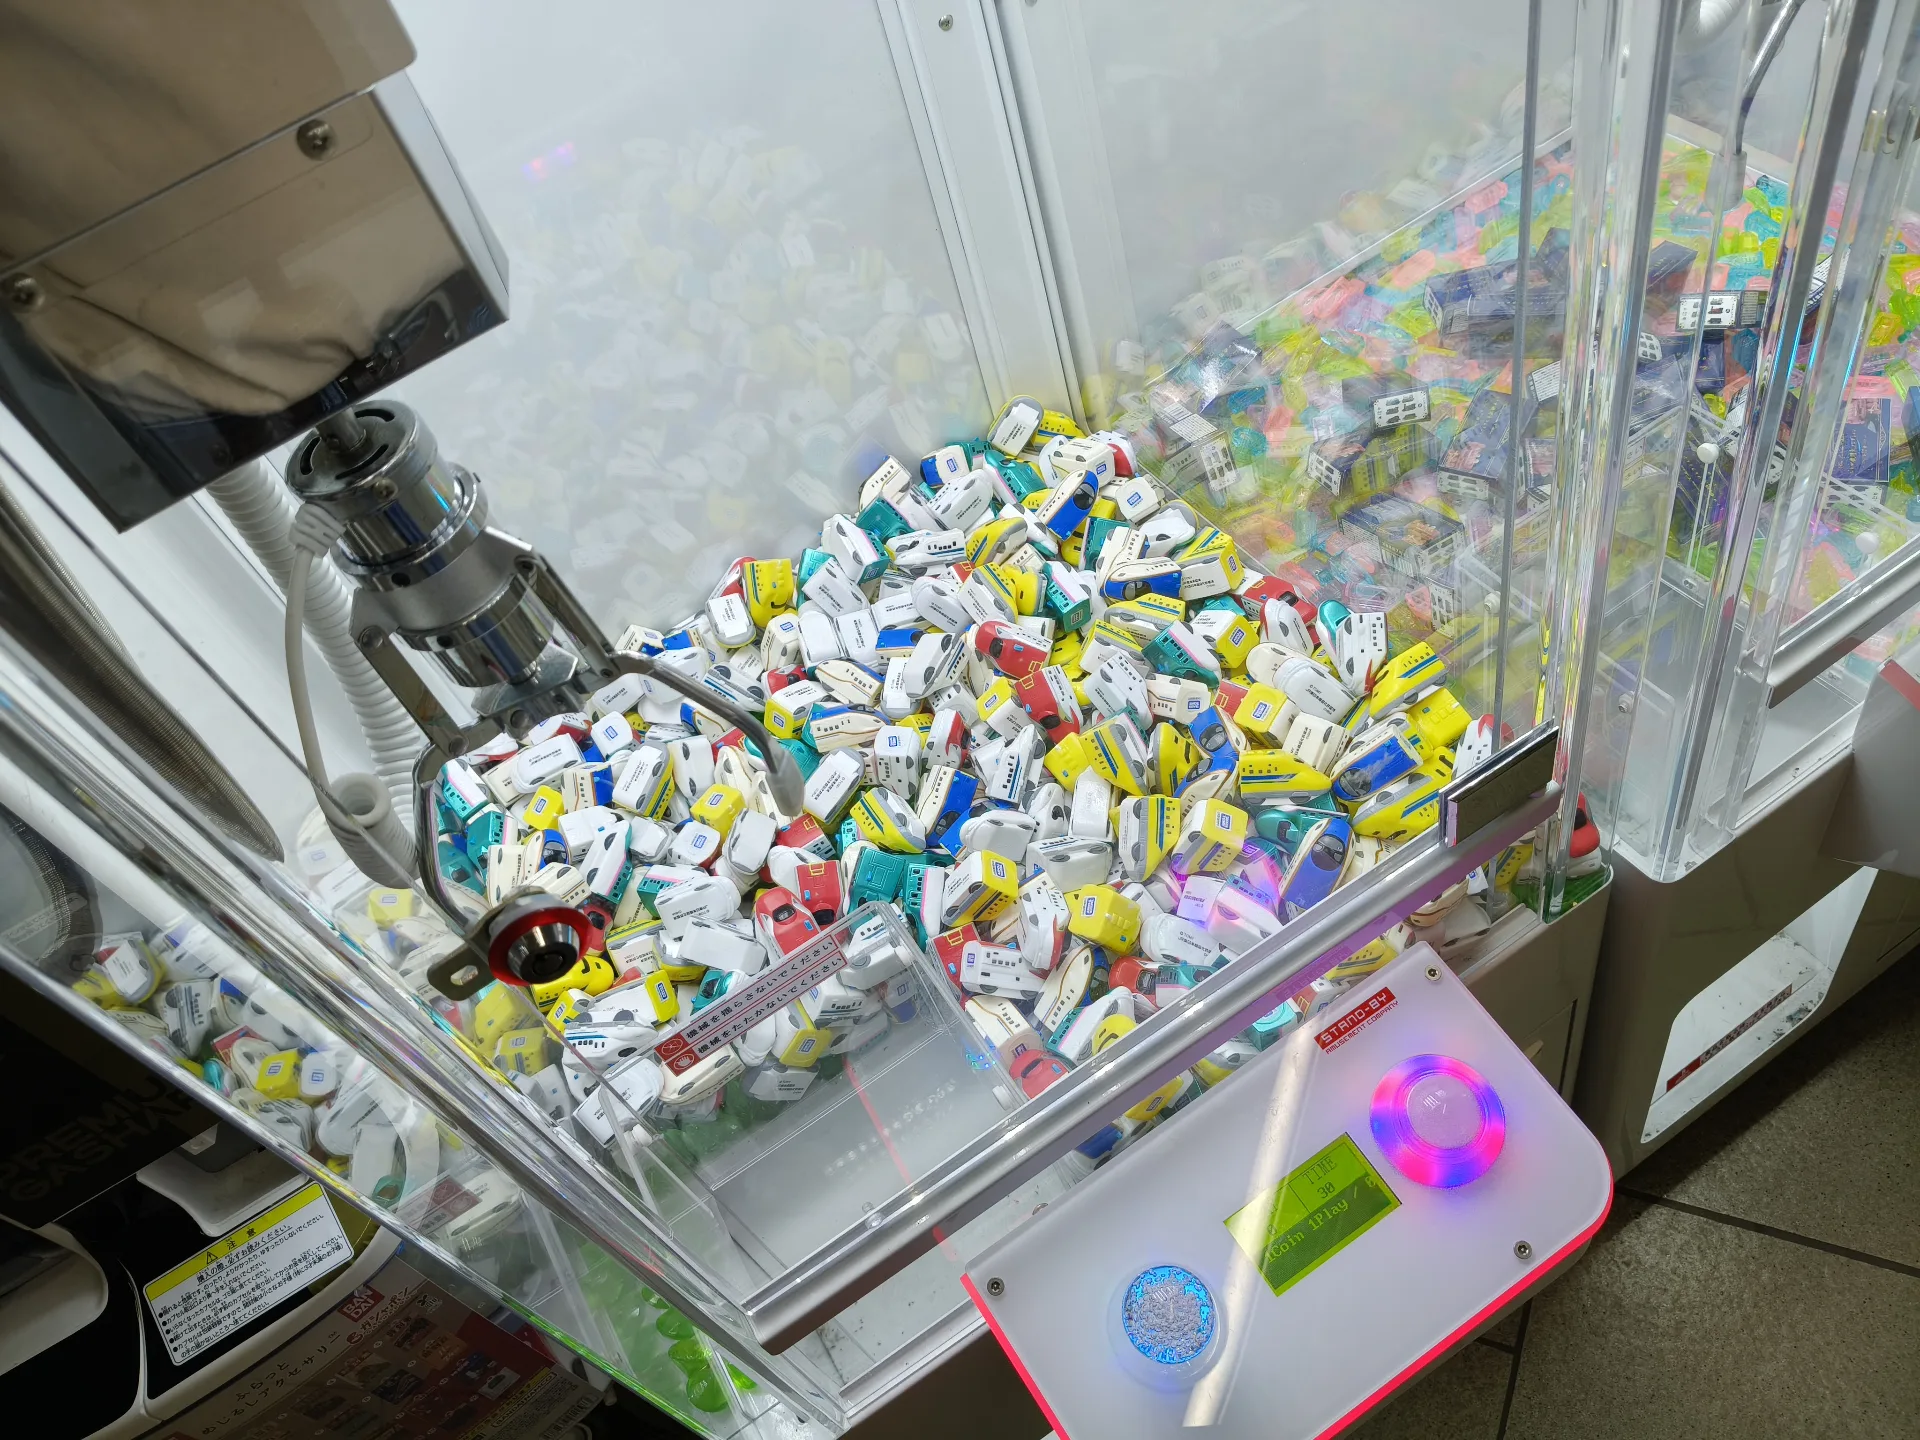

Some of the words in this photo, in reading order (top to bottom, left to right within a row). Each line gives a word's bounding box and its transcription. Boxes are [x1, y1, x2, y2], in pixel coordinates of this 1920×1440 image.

[686, 939, 833, 1039] 機械を揺らさないでください
[697, 956, 842, 1054] 機械をたたかないでください
[1321, 992, 1387, 1043] STAND-BY
[1325, 1022, 1367, 1054] AMUSEMENT
[1366, 1000, 1398, 1025] COMPANY
[1302, 1155, 1337, 1185] TIME
[1316, 1180, 1336, 1199] 30
[1307, 1197, 1349, 1230] 1Play
[342, 1286, 372, 1313] BAN
[350, 1297, 374, 1318] DAI
[201, 1335, 341, 1435] めじるしアクセサリー
[234, 1359, 289, 1401] ふらっと
